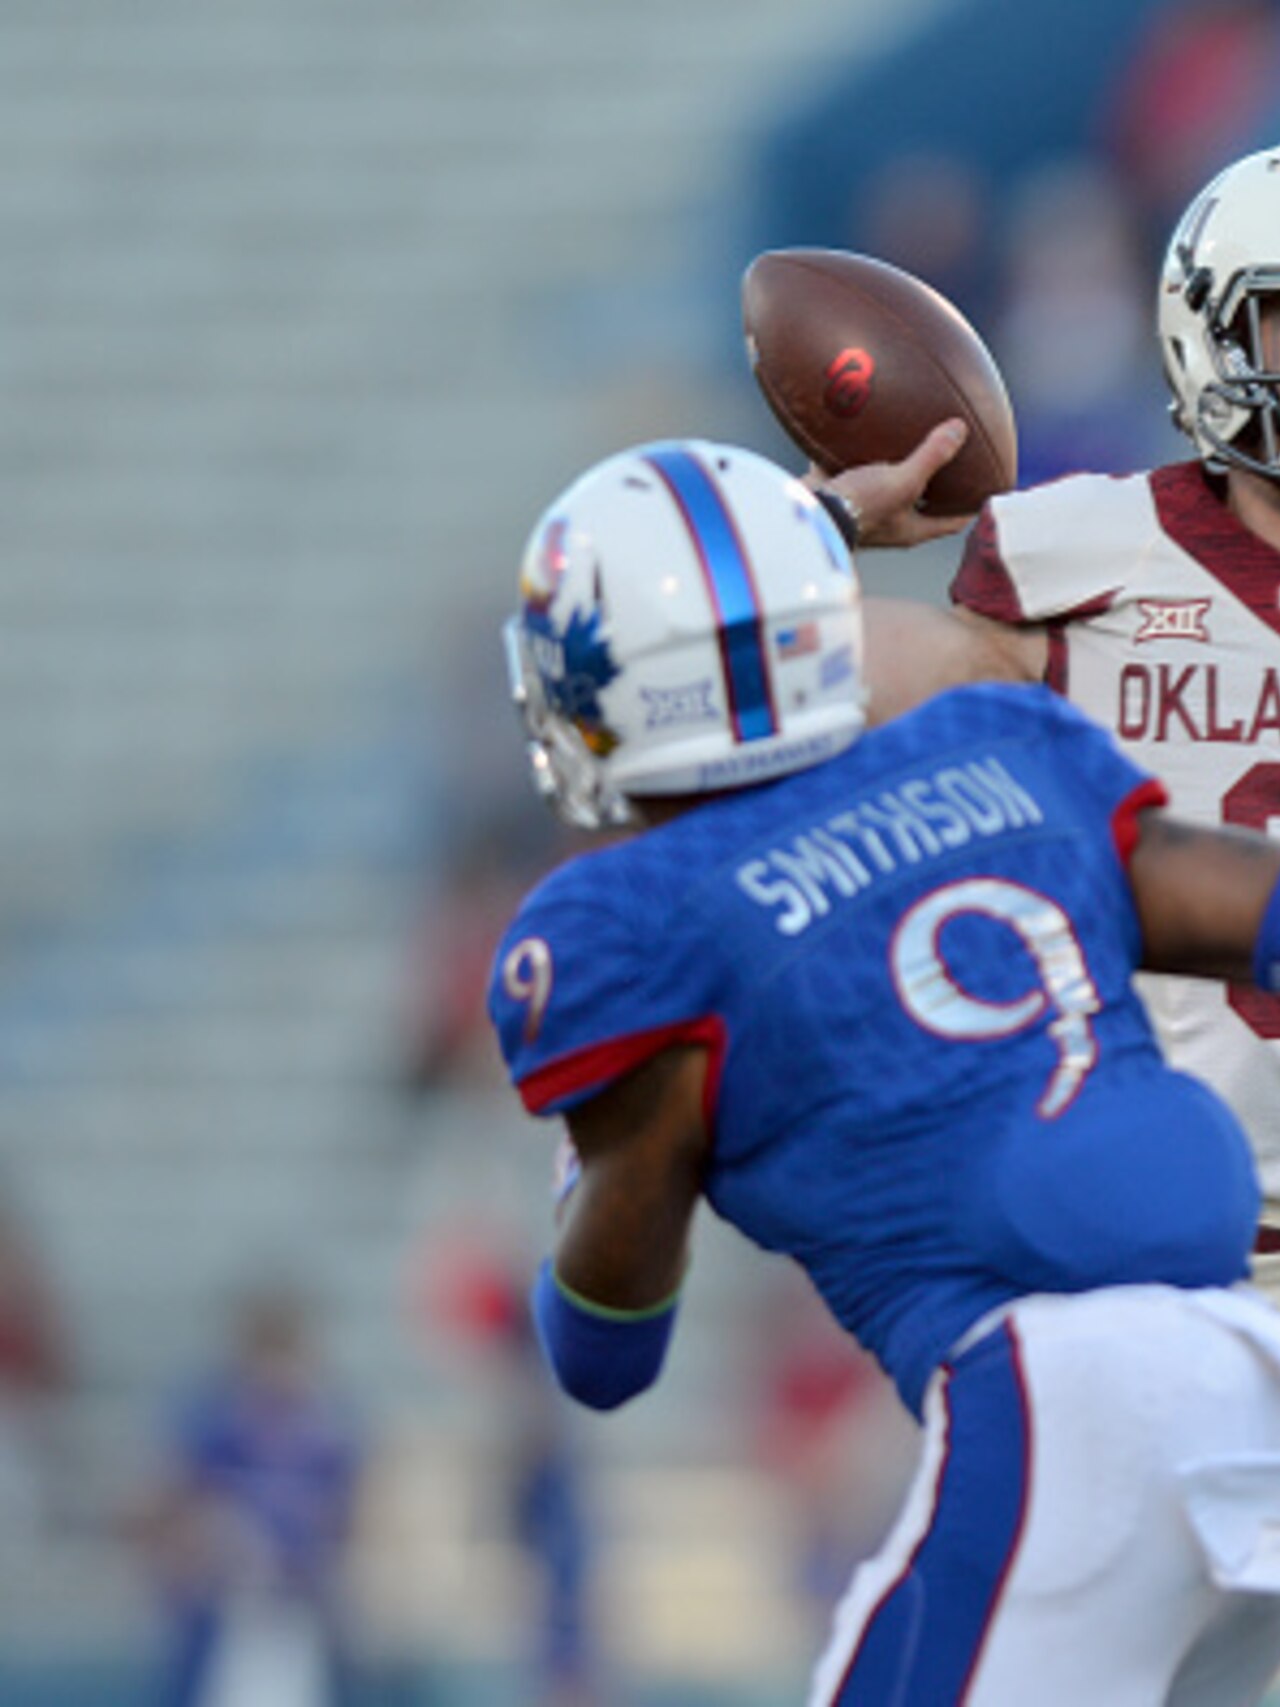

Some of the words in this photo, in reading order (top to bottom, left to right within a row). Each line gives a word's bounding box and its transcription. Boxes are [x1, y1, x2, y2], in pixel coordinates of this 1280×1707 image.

[1134, 597, 1212, 645] XII
[736, 756, 1045, 936] SMITHSON
[503, 936, 554, 1046] 9
[890, 876, 1103, 1121] 9
